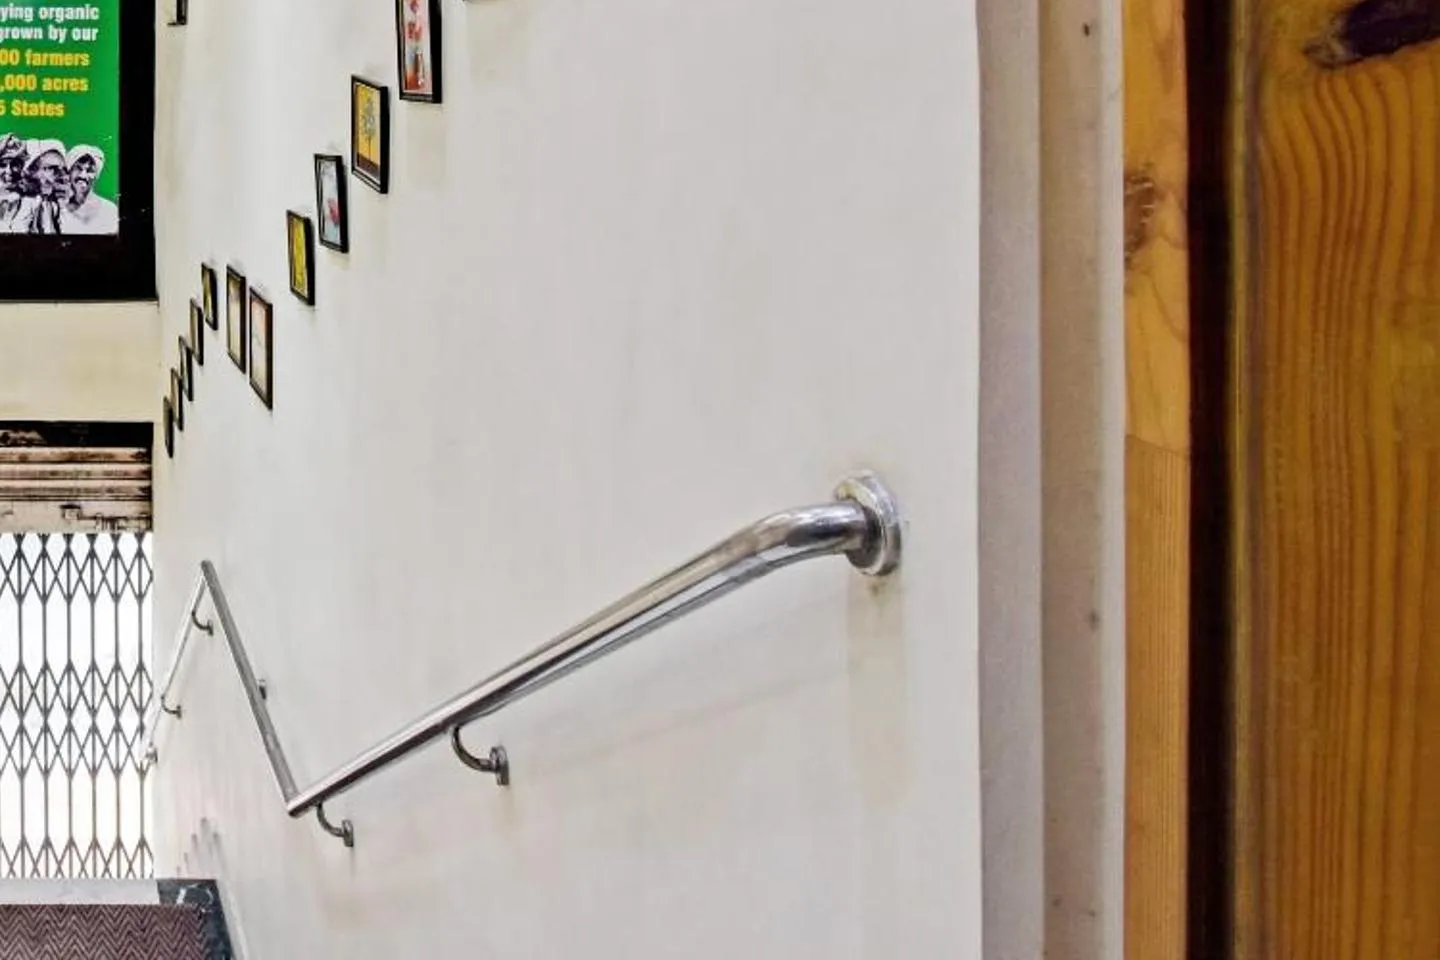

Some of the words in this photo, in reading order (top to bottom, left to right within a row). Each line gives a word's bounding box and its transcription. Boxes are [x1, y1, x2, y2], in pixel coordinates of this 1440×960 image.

[39, 3, 100, 23] organic
[48, 24, 68, 44] by
[71, 27, 99, 41] our
[25, 48, 90, 66] farmers
[42, 77, 89, 91] acres
[11, 99, 65, 117] States
